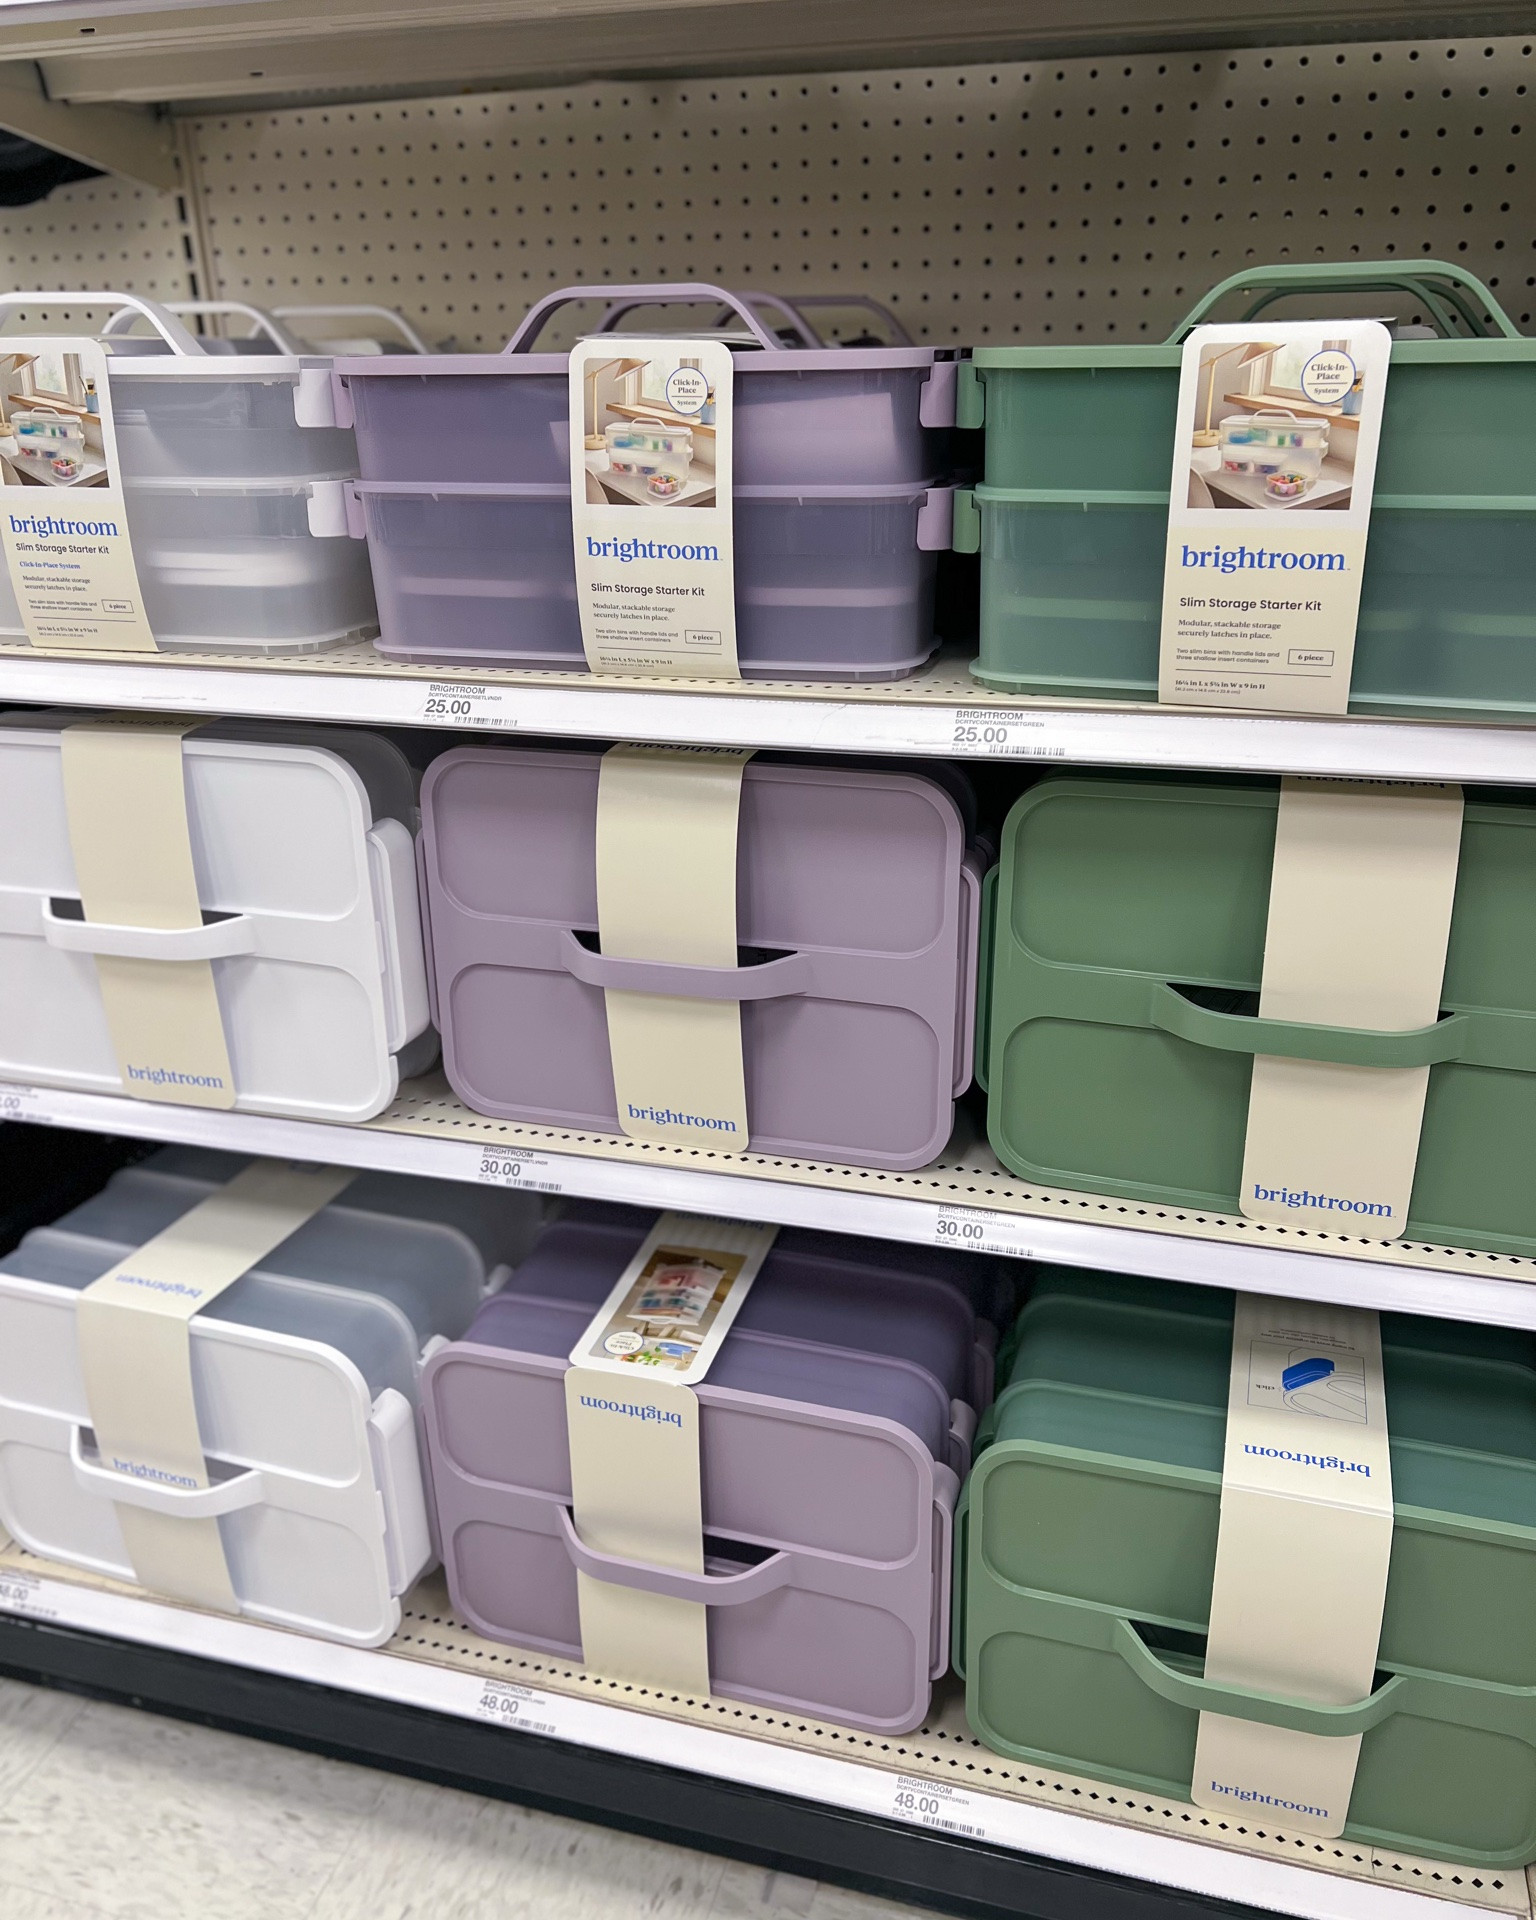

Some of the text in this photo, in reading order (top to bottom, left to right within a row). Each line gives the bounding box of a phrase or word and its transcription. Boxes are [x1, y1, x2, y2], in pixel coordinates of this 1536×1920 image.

[1311, 363, 1348, 371] Click-In-
[1317, 372, 1340, 380] Place
[9, 515, 118, 538] brightroom
[16, 543, 110, 554] Slim Storage Starter Kit
[586, 536, 719, 563] brightroom
[1181, 545, 1345, 574] brightroom
[591, 583, 705, 597] Slim Storage Starter Kit
[592, 602, 675, 613] Modular, stackable storage
[1180, 597, 1322, 612] Slim Storage Starter Kit
[594, 612, 619, 620] securely
[620, 612, 642, 620] latches
[652, 614, 669, 622] place.
[1178, 619, 1281, 630] Modular, stackable storage
[1177, 630, 1272, 640] securely latches in place.
[1304, 654, 1324, 662] piece
[430, 684, 485, 694] BRIGHTROOM
[425, 699, 471, 715] 25.00
[956, 710, 1023, 720] BRIGHTROOM
[953, 726, 1008, 743] 25.00
[127, 1064, 223, 1088] brightroom
[628, 1104, 737, 1132] brightroom
[483, 1146, 534, 1158] BRIGHTROOM
[480, 1160, 520, 1177] 30.00
[1254, 1184, 1393, 1218] brightroom
[938, 1205, 998, 1219] BRIGHTROOM
[936, 1220, 983, 1239] 30.00
[580, 1395, 683, 1428] brightroom
[1244, 1443, 1371, 1478] brightroom
[113, 1457, 198, 1488] brightroom
[485, 1680, 533, 1696] BRIGHTROOM
[480, 1694, 519, 1714] 48.00
[897, 1776, 953, 1795] BRIGHTROOM
[894, 1792, 939, 1815] 48.00
[1211, 1781, 1328, 1818] brightroom
